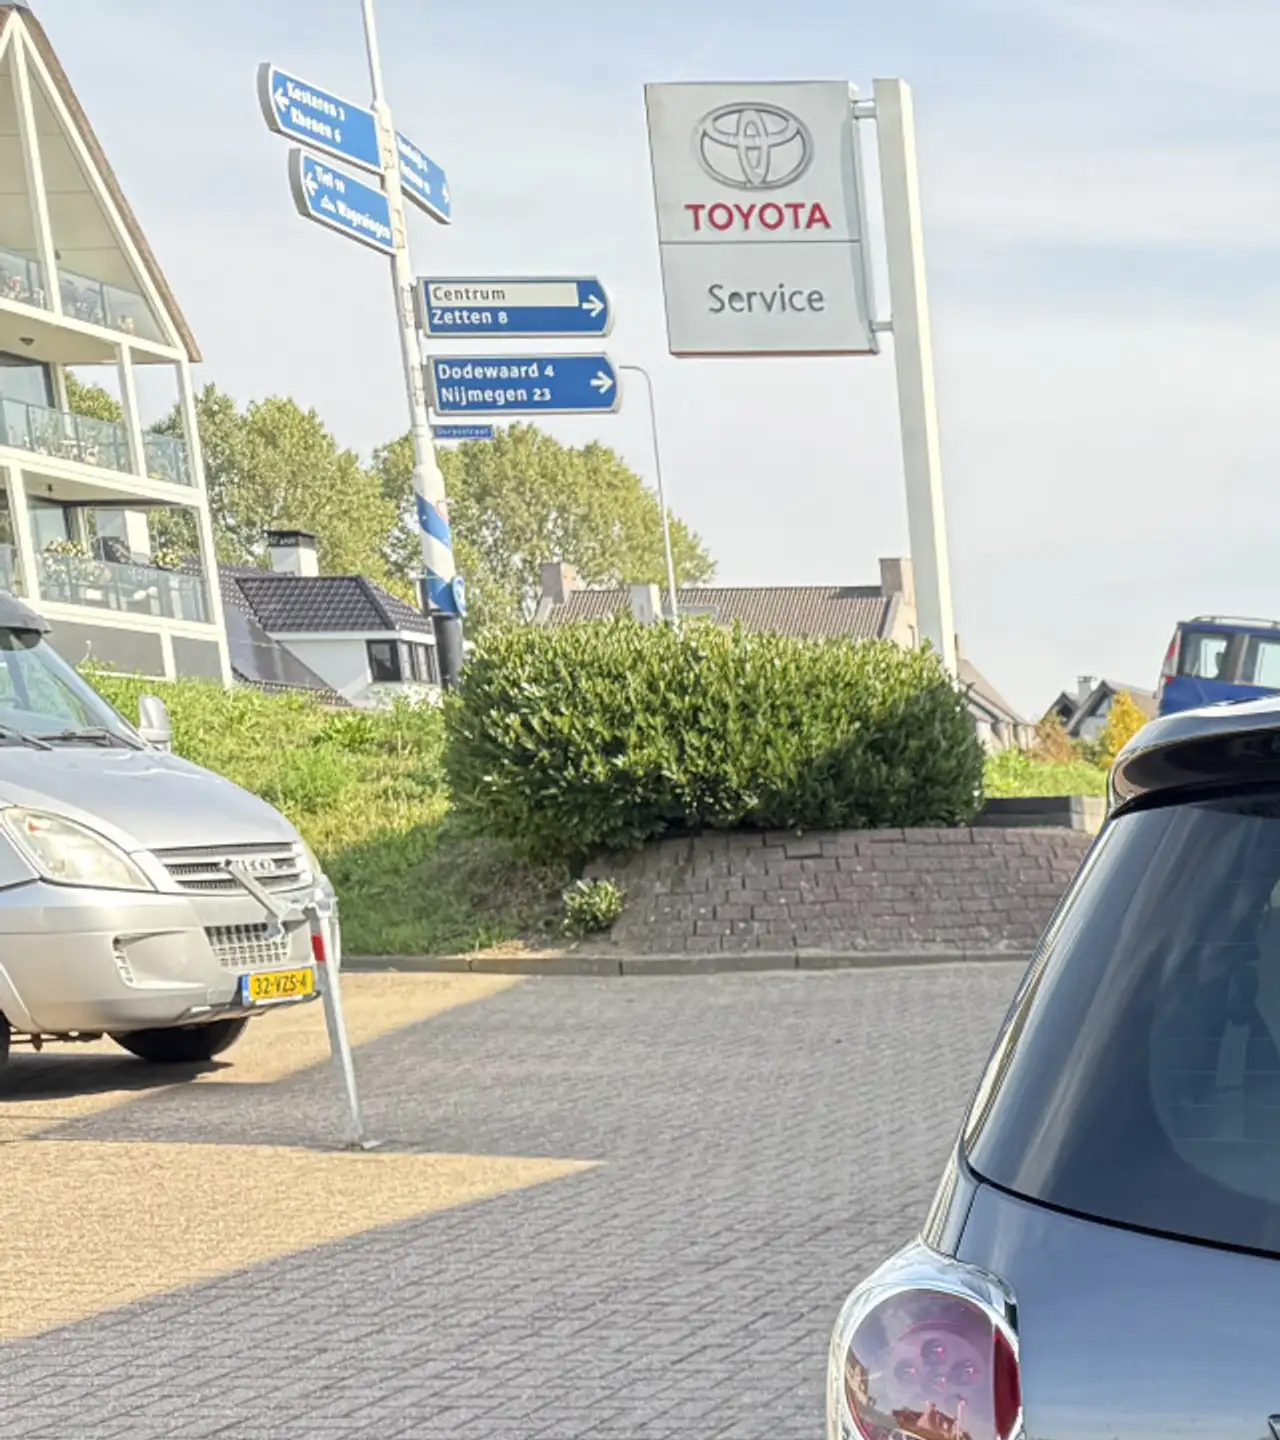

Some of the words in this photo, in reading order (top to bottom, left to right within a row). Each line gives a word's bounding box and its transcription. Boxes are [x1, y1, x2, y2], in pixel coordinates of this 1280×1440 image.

[684, 202, 832, 231] TOYOTA
[433, 287, 506, 301] Centrum
[707, 283, 825, 313] Service
[432, 309, 492, 325] Zetten
[498, 311, 508, 324] 8
[437, 363, 539, 379] Dodewaard
[544, 365, 555, 377] 4
[441, 387, 527, 406] Nijmegen
[533, 388, 551, 401] 23
